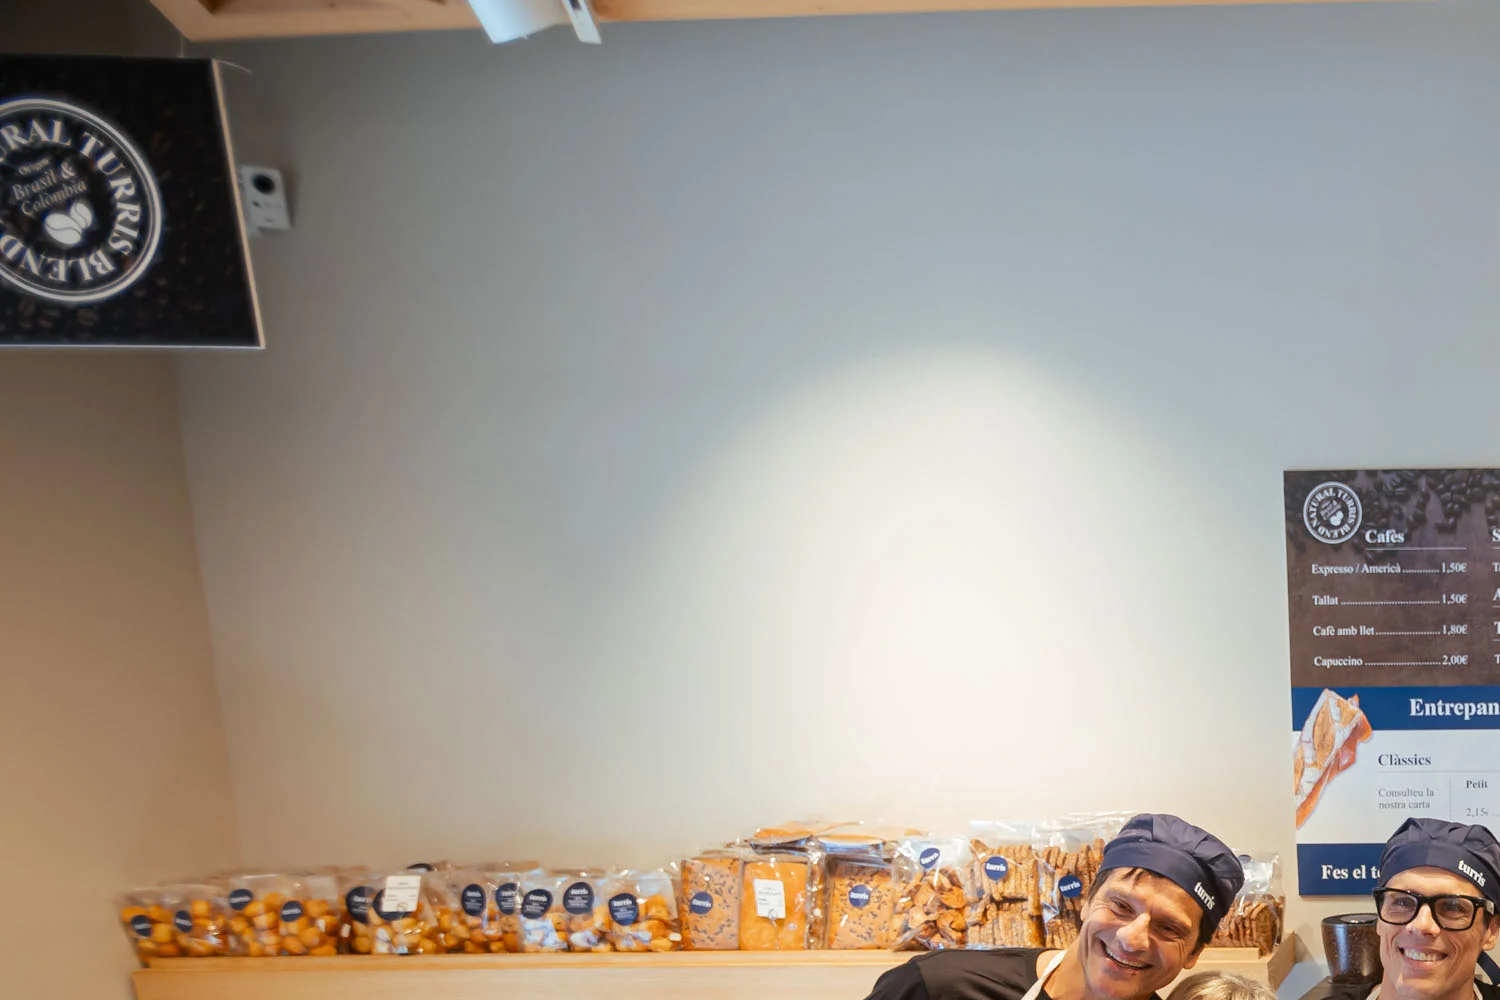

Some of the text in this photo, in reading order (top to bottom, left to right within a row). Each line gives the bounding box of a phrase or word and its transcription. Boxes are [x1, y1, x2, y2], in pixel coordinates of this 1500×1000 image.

[61, 161, 76, 179] &
[80, 132, 142, 256] TURRIS
[0, 234, 115, 282] BLEND
[1365, 529, 1405, 544] Cafès
[1311, 563, 1354, 576] Expresso
[1361, 562, 1401, 574] Americà
[1441, 562, 1468, 574] 1,50€
[1312, 593, 1468, 606] Tallat 1,50€
[1313, 624, 1468, 636] Cafè amb llet 1,80€
[1314, 655, 1468, 669] Capuccino 2,00€
[1378, 754, 1431, 767] Clàssics
[1466, 779, 1488, 789] Petit
[1378, 788, 1435, 798] Consulteu la
[1378, 801, 1430, 809] nostra carta
[1321, 864, 1349, 879] Fes
[1352, 864, 1367, 879] el
[1458, 859, 1487, 888] turris
[1060, 880, 1081, 893] turris
[1194, 881, 1216, 911] turris
